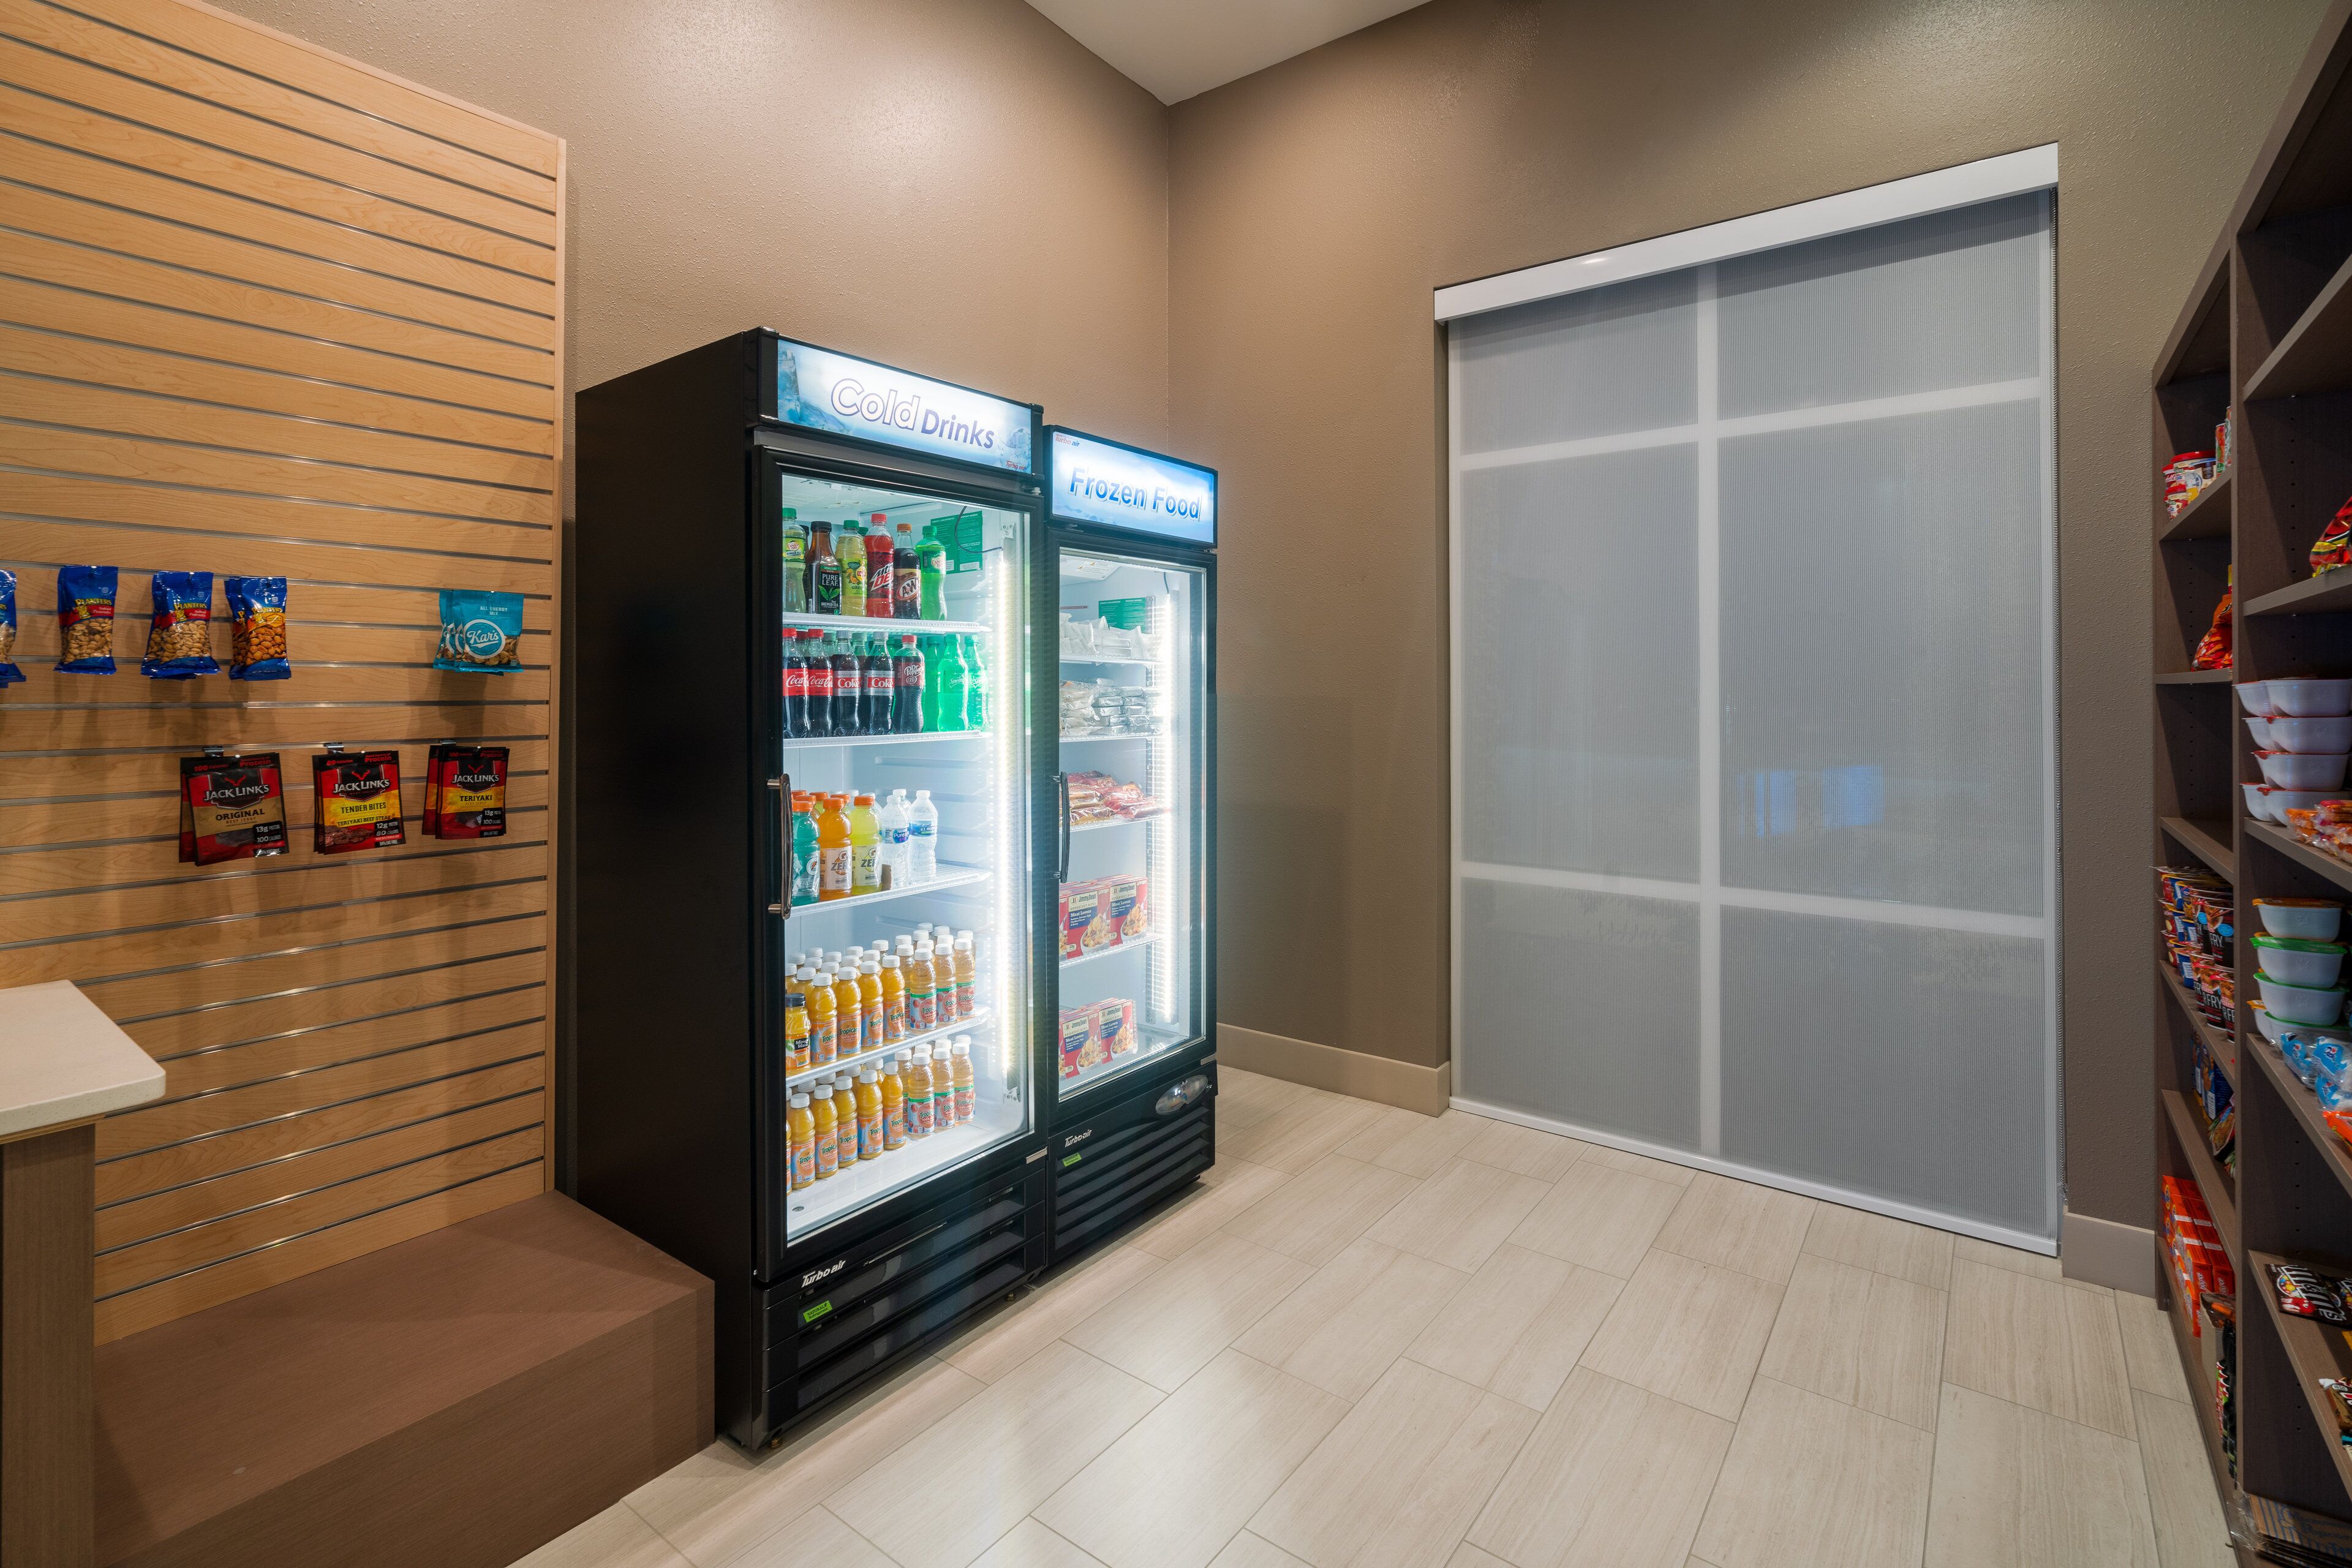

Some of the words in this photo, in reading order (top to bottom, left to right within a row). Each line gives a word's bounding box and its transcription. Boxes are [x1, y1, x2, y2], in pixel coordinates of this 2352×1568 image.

[831, 378, 921, 431] Cold
[921, 409, 995, 449] Drinks
[1055, 434, 1071, 445] Turbo
[1069, 467, 1146, 508] Frozen
[1152, 486, 1202, 520] Food
[902, 577, 919, 598] A&W
[466, 630, 499, 644] Kar's
[904, 665, 922, 676] Pepper
[837, 678, 860, 688] Coke
[872, 678, 894, 688] Coke
[452, 775, 474, 783] JACK
[333, 782, 360, 793] JACK
[360, 779, 390, 789] LINK'S
[204, 789, 235, 801] JACK
[236, 785, 270, 796] LINK'S
[341, 804, 368, 813] TENDER
[216, 809, 265, 821] ORIGINAL
[2209, 933, 2223, 948] FRY
[890, 1012, 905, 1021] Tropica
[869, 1019, 883, 1027] Tropica
[822, 1033, 837, 1042] Tropica
[891, 1118, 903, 1127] Tropic
[1065, 1135, 1082, 1148] Turbo
[1082, 1129, 1092, 1139] air
[821, 1144, 838, 1155] Tropica
[801, 1268, 831, 1288] Turbo
[831, 1260, 846, 1273] air
